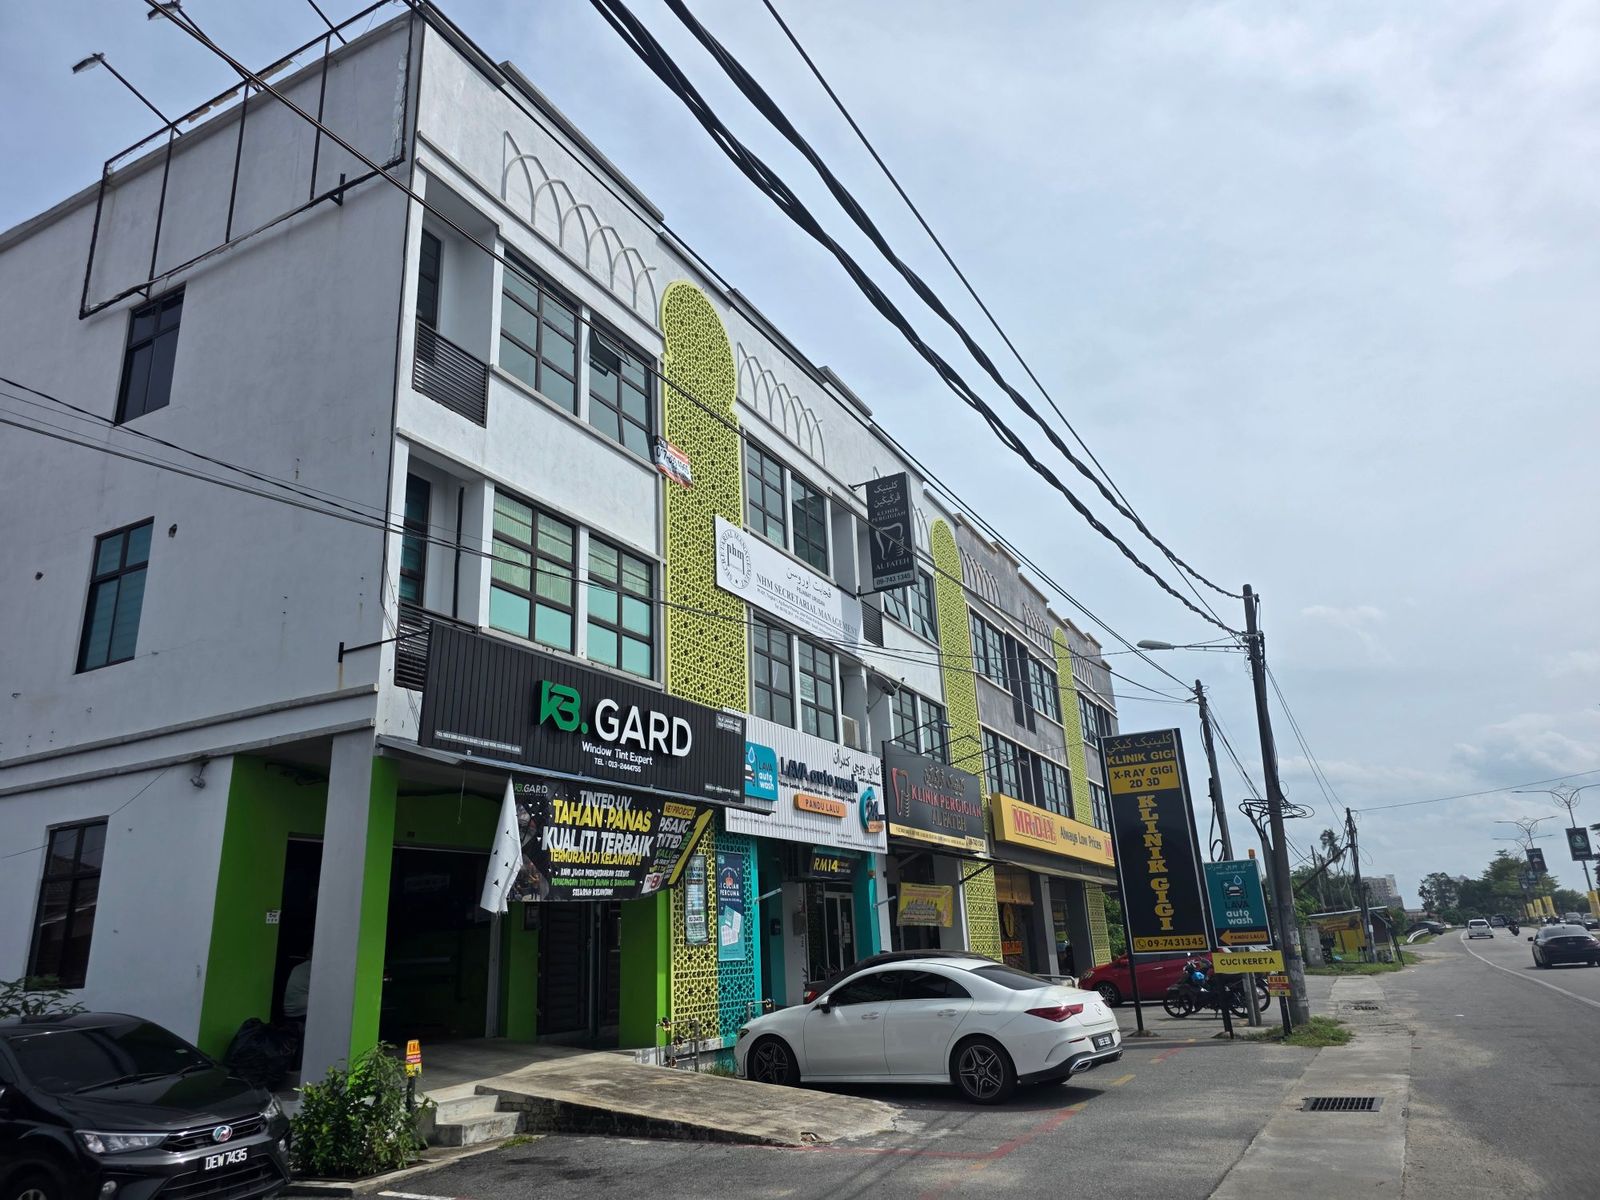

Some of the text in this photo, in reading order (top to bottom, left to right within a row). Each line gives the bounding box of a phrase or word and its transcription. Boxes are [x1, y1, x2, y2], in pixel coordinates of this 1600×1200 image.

[727, 543, 745, 575] nhm
[756, 573, 773, 590] NHM
[774, 581, 818, 615] SECRETARIAL
[818, 609, 857, 634] MANAGEMENT
[595, 698, 692, 757] GARD
[582, 740, 653, 765] Window Tint Expert
[1106, 749, 1175, 765] KLINIK GIGI
[594, 757, 604, 766] TEL
[759, 762, 773, 771] LAVA
[759, 772, 773, 783] auto
[781, 757, 808, 780] LAVA
[810, 770, 834, 787] auto
[834, 774, 858, 793] wash
[1113, 765, 1173, 780] X-RAY GIGI
[759, 781, 775, 790] wash
[1129, 777, 1160, 788] 2D 3D
[580, 790, 632, 811] TINTED UV
[805, 799, 840, 813] PANDU LALU
[911, 785, 982, 817] KLINIK PERGIGIAN
[553, 799, 652, 832] TAHAN PANAS
[542, 826, 597, 853] KUALITI
[600, 831, 654, 857] TERBAIK
[1061, 826, 1102, 850] Always Low Prices
[550, 848, 591, 864] TERMURAH
[591, 853, 600, 865] DI
[601, 855, 635, 866] KELANTAN
[813, 857, 838, 873] RM14
[1137, 794, 1174, 930] KLINIK GIGI
[1226, 910, 1250, 919] auto
[1228, 916, 1253, 925] wash
[1147, 938, 1204, 948] 09-7431345
[1220, 957, 1275, 966] CUCI KERETA
[205, 1148, 248, 1170] DEW 7435
